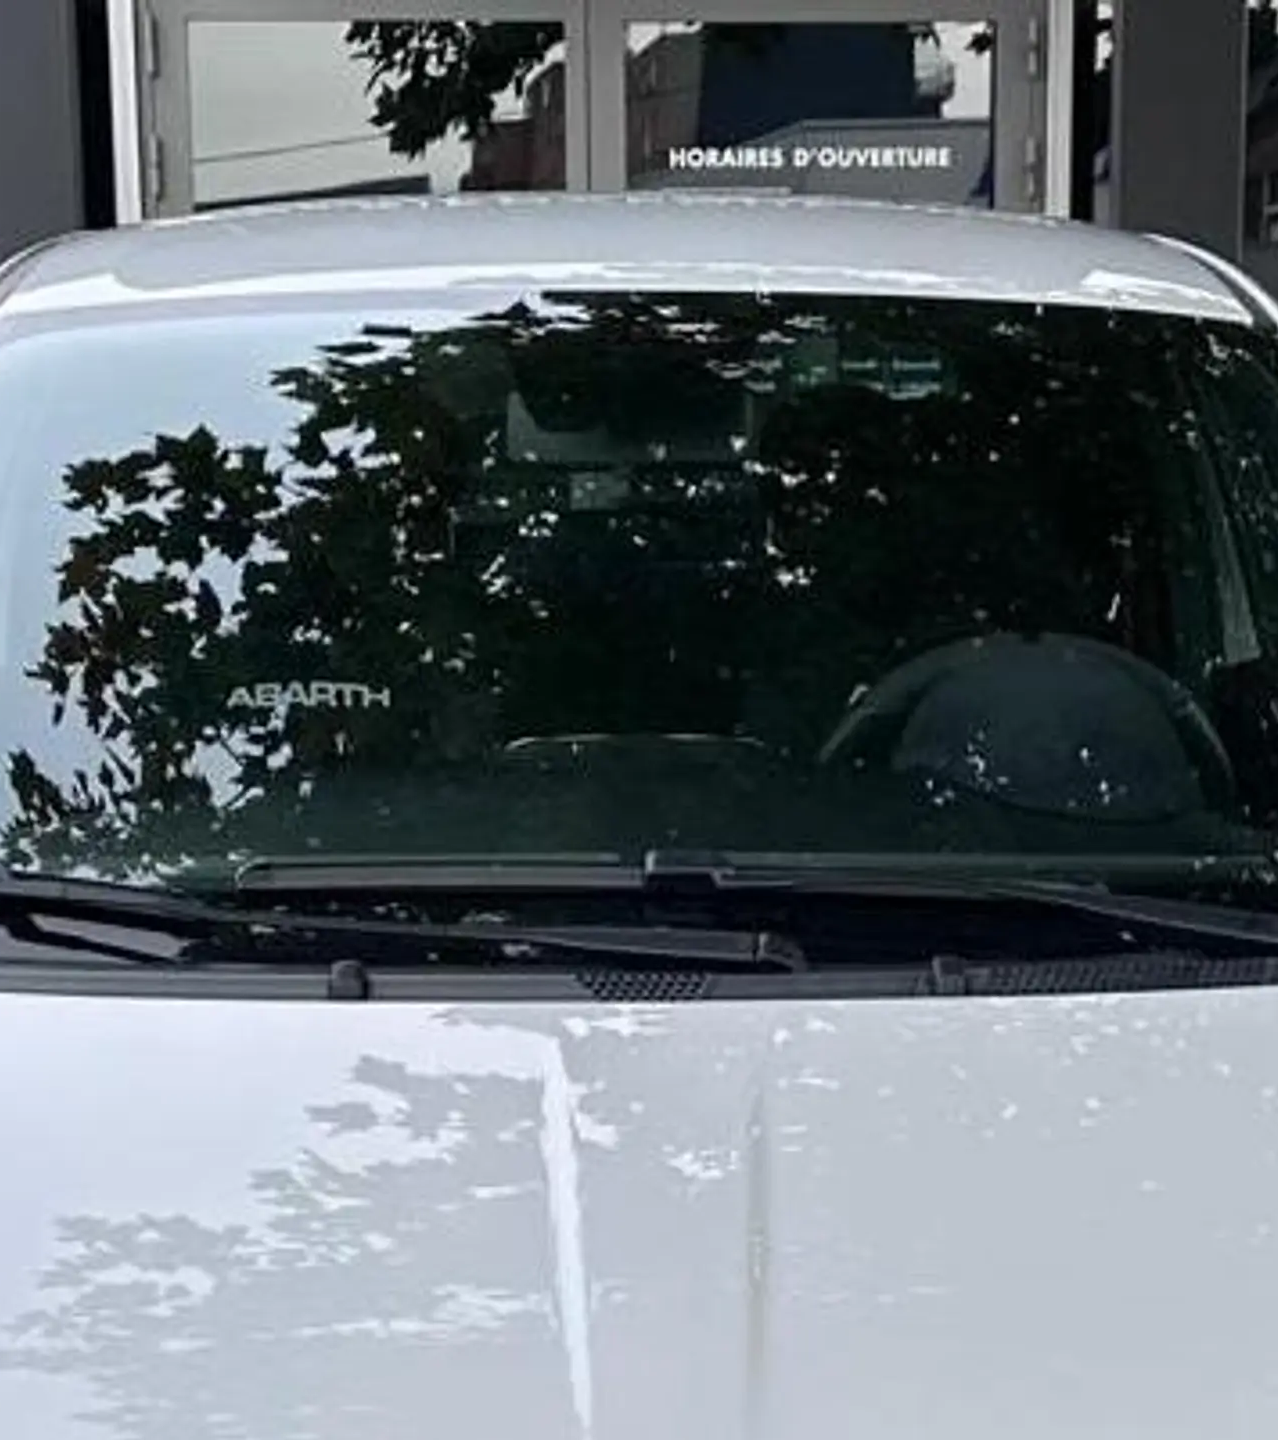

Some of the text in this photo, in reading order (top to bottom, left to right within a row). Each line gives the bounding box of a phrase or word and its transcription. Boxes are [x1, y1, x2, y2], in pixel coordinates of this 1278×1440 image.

[669, 147, 951, 168] HORAIRES D'OUVERTURE
[226, 682, 391, 709] ABARTH
